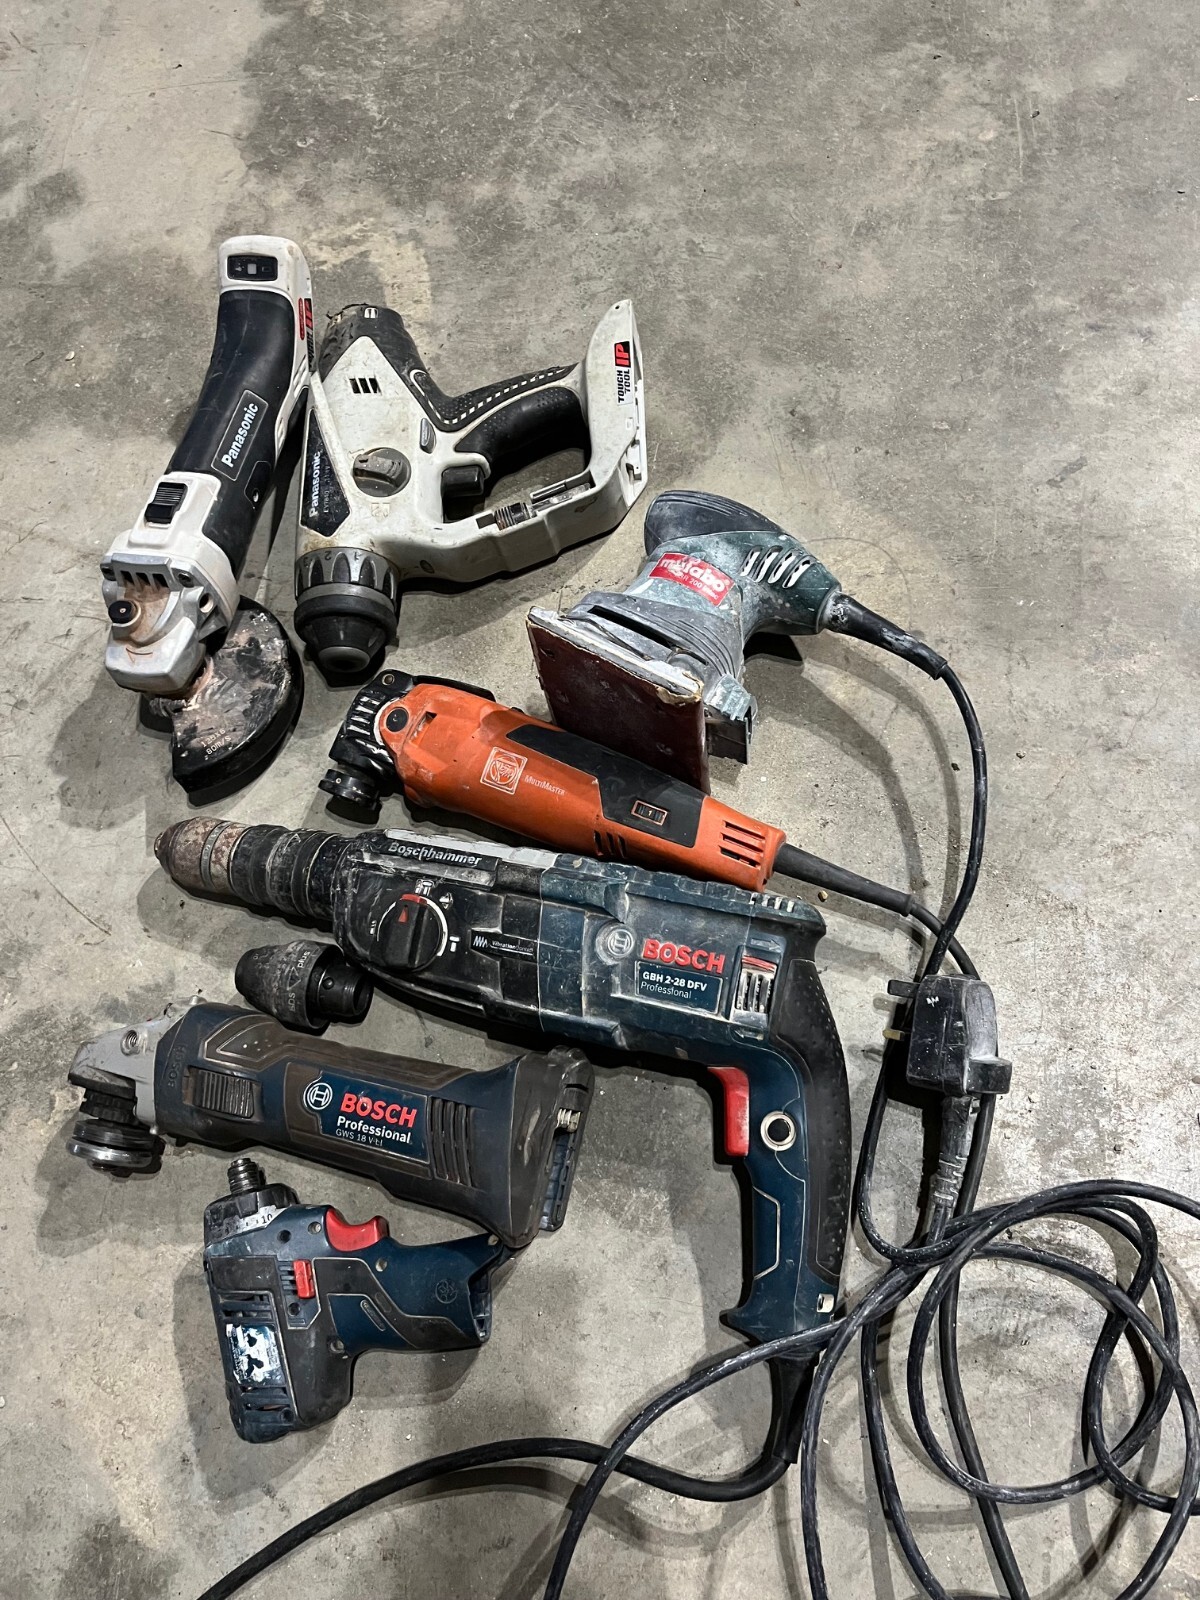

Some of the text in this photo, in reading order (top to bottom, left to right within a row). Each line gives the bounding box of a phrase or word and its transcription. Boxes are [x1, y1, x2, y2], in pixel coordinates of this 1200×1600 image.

[617, 370, 625, 404] TOUGH
[221, 403, 259, 468] Panasonic
[309, 451, 321, 518] Panasonic
[660, 558, 725, 592] mtabo
[388, 841, 482, 866] Boschhammer
[297, 951, 311, 968] plus
[642, 938, 726, 974] BOSCH
[640, 981, 692, 999] Professional
[642, 971, 707, 992] GBH 2-28 DFV
[340, 1092, 418, 1128] BOSCH
[335, 1128, 355, 1139] GWS
[356, 1133, 367, 1143] 18
[336, 1115, 412, 1144] Professional
